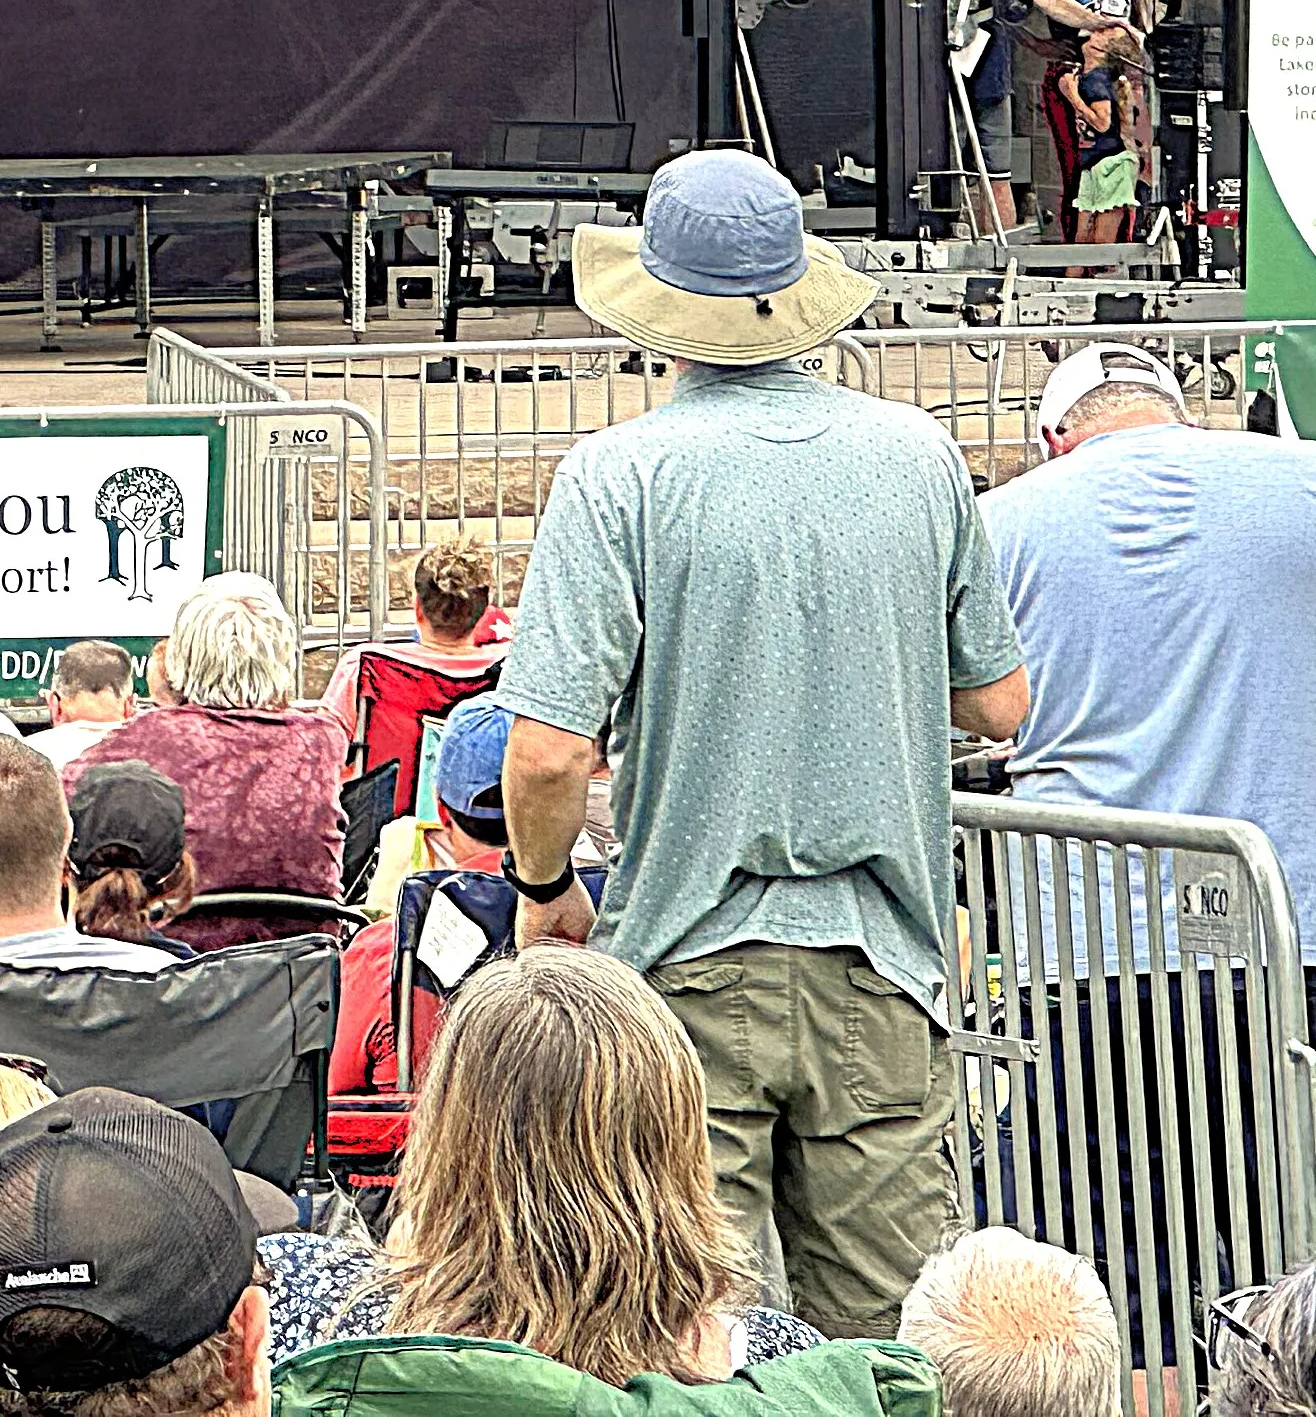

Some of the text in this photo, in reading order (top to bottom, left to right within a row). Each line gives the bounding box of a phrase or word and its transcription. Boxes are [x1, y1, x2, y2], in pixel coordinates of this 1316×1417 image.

[1279, 57, 1314, 71] Lake
[270, 430, 328, 444] SNCO
[1183, 884, 1230, 918] SNCO
[4, 1267, 70, 1289] Avalanche
